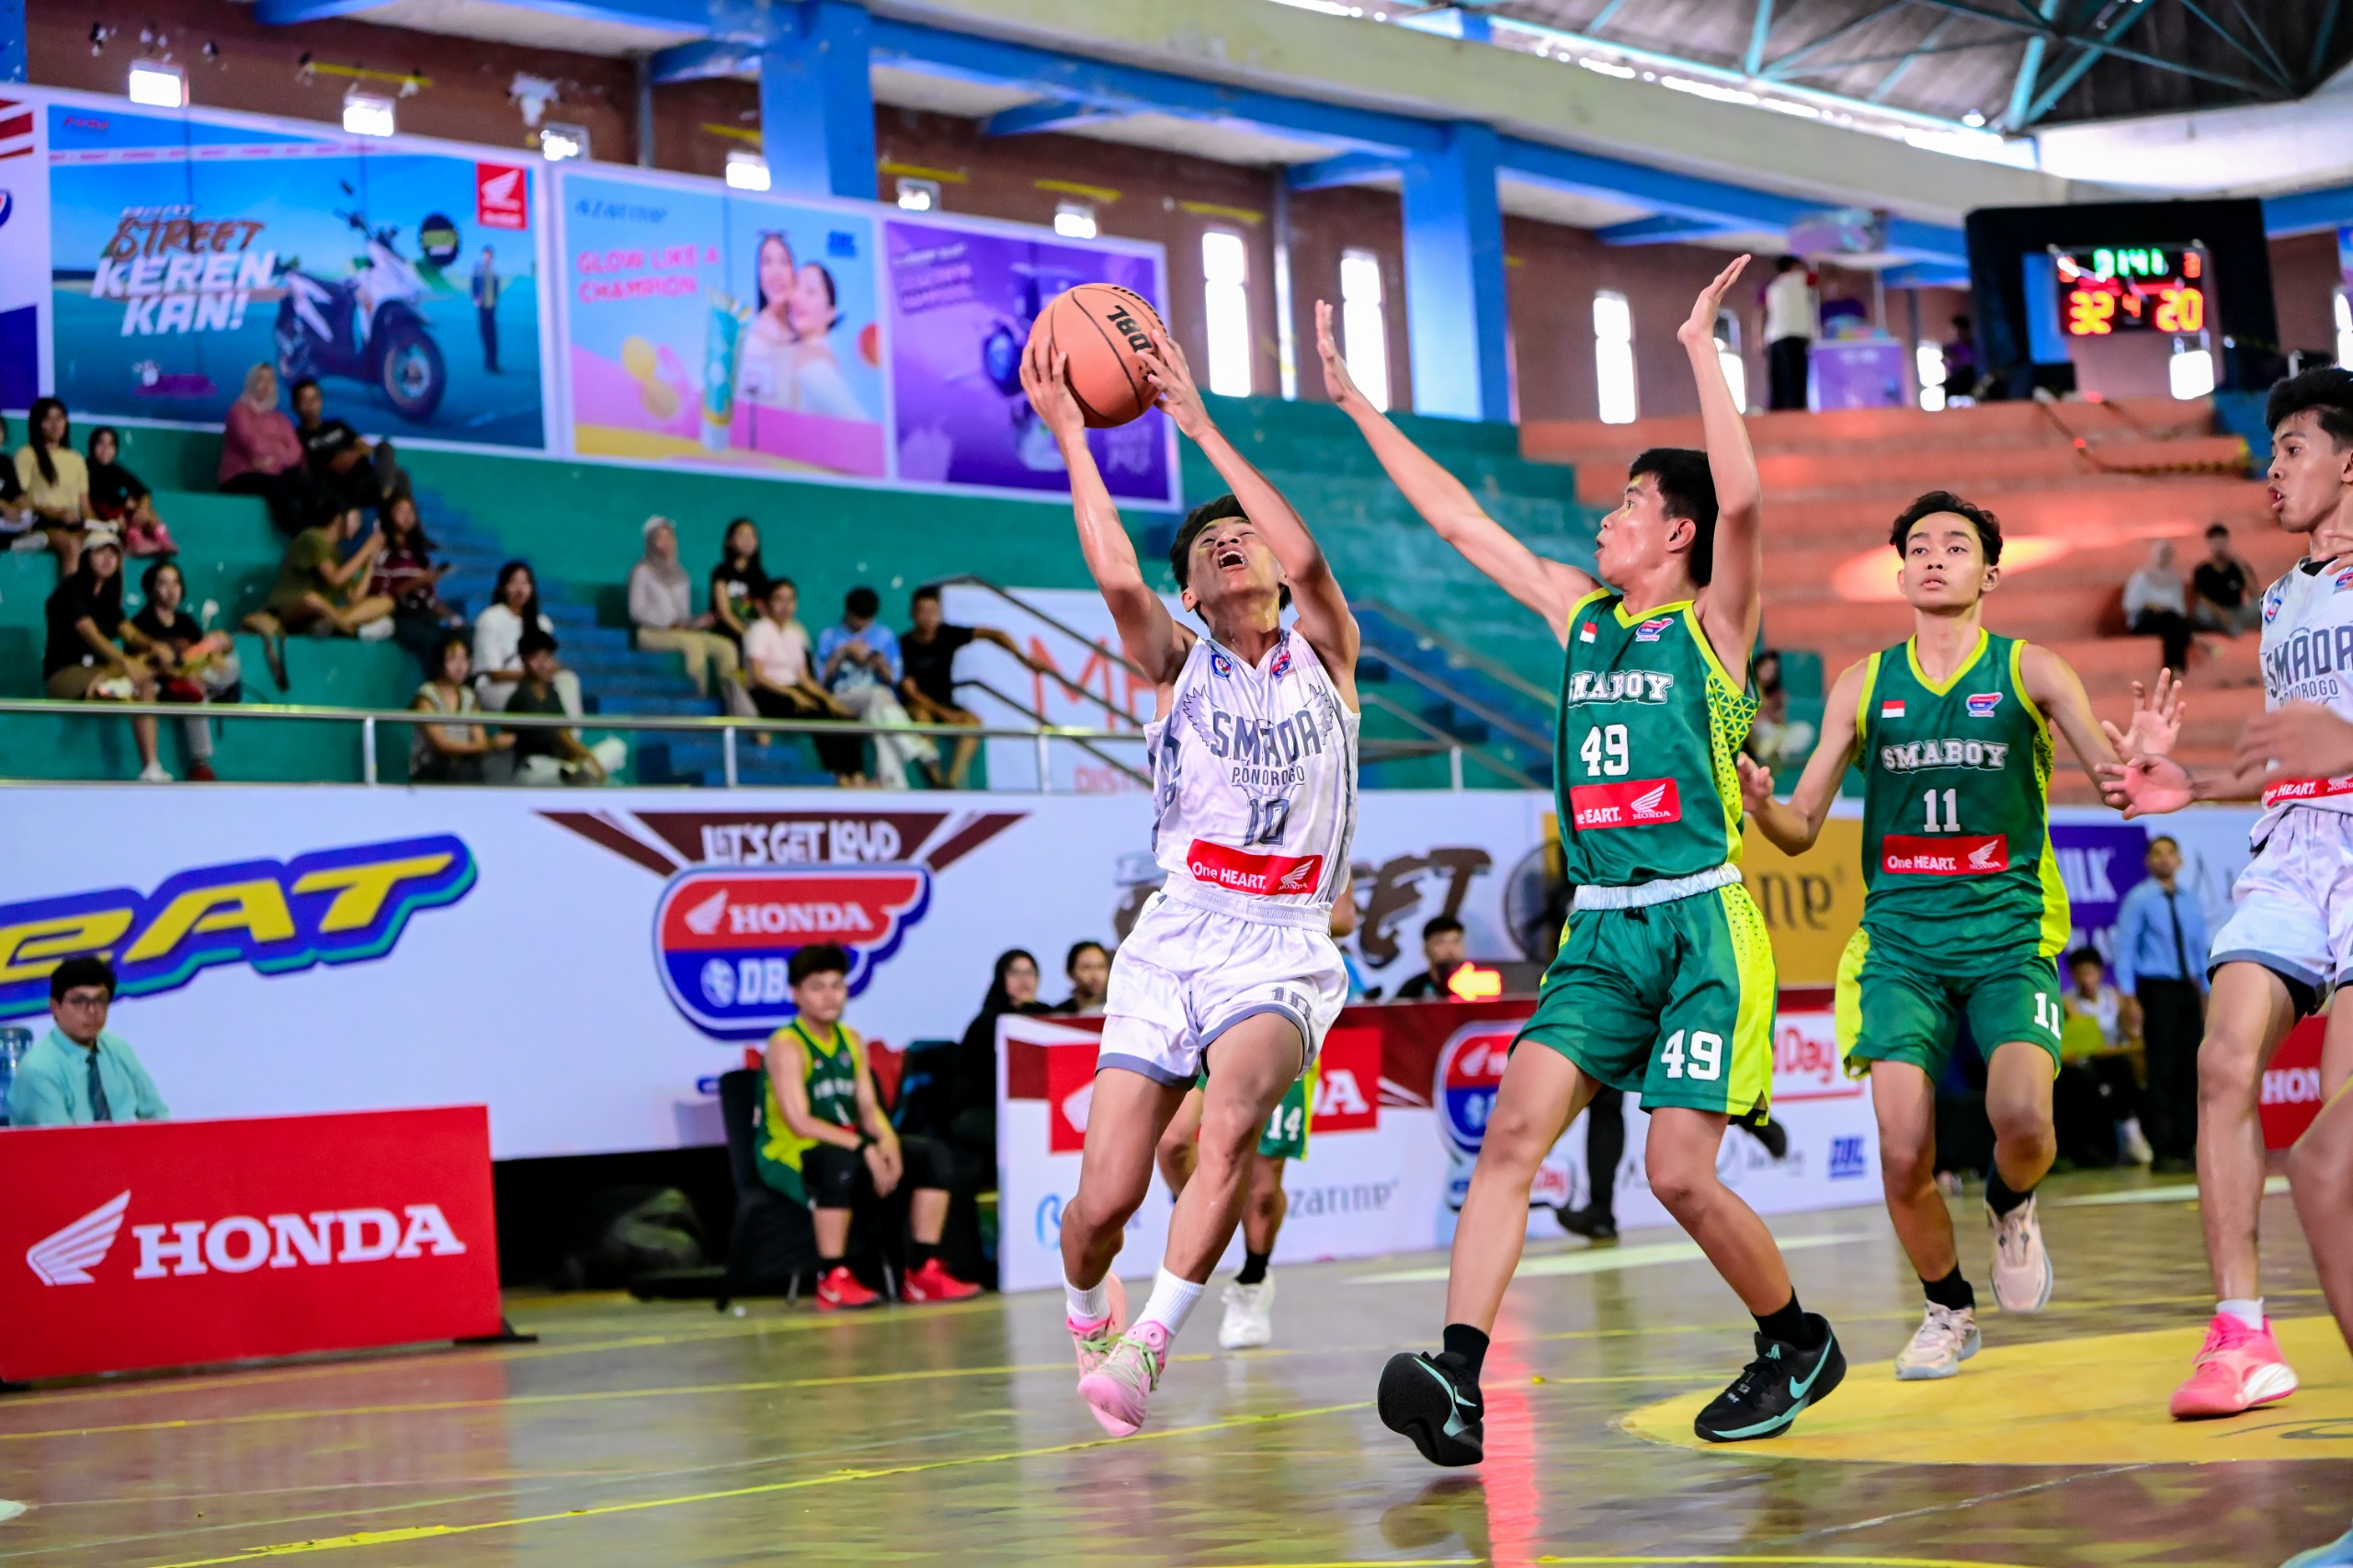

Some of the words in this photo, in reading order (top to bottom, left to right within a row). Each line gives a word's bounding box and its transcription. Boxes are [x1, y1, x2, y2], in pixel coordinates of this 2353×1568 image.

[90, 251, 276, 298] KEREN
[576, 249, 644, 275] GLOW
[650, 244, 699, 270] LIKE
[705, 244, 719, 265] A
[578, 275, 699, 304] CHAMPION
[2156, 288, 2204, 333] 20
[120, 291, 248, 336] KAN!
[2069, 290, 2115, 335] 32
[2266, 625, 2353, 699] SMADA
[1569, 670, 1673, 706] MABOY
[1210, 710, 1322, 768] SMADA
[1580, 723, 1630, 777] 49
[1881, 739, 2008, 774] SMABOY
[1231, 765, 1305, 787] PONOROGO
[2278, 781, 2316, 798] HEART.
[1242, 798, 1290, 847] 10
[1632, 811, 1671, 820] HONDA
[1923, 788, 1961, 833] 11
[769, 820, 826, 864] GET
[828, 818, 902, 864] LOUD
[1887, 855, 1913, 869] One
[1914, 856, 1957, 870] HEART.
[1192, 861, 1218, 880] One
[1220, 868, 1267, 890] HEART.
[1279, 882, 1308, 892] HONDA
[1970, 861, 2001, 870] HONDA
[727, 901, 873, 935] HONDA
[737, 957, 796, 1006] DB
[2033, 992, 2062, 1040] 11
[1660, 1028, 1723, 1082] 49
[1783, 1025, 1837, 1085] Day
[1267, 1103, 1302, 1142] 14
[132, 1204, 466, 1280] HONDA
